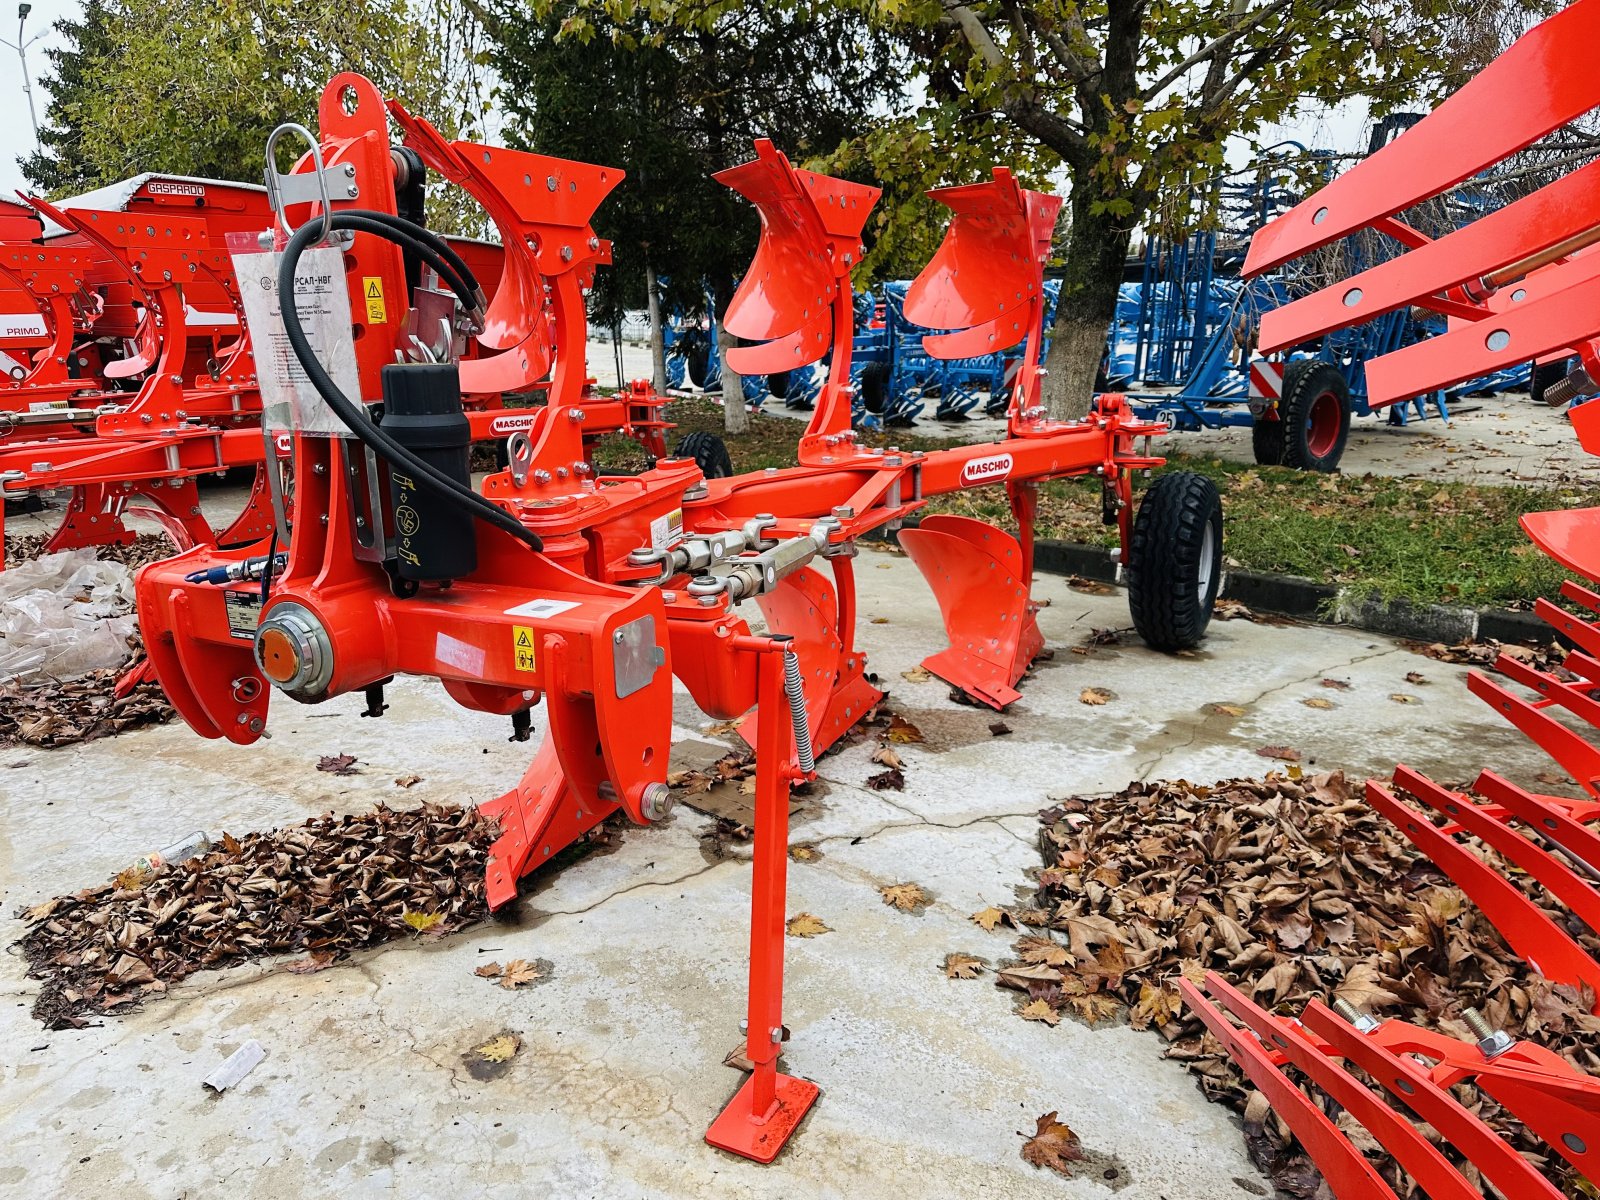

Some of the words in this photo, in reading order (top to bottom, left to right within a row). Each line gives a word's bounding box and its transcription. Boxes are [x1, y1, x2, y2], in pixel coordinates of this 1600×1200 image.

[148, 183, 204, 195] GASPARDO
[6, 327, 41, 336] PRIMO
[1160, 411, 1174, 429] 25
[967, 458, 1010, 477] MASCHIO
